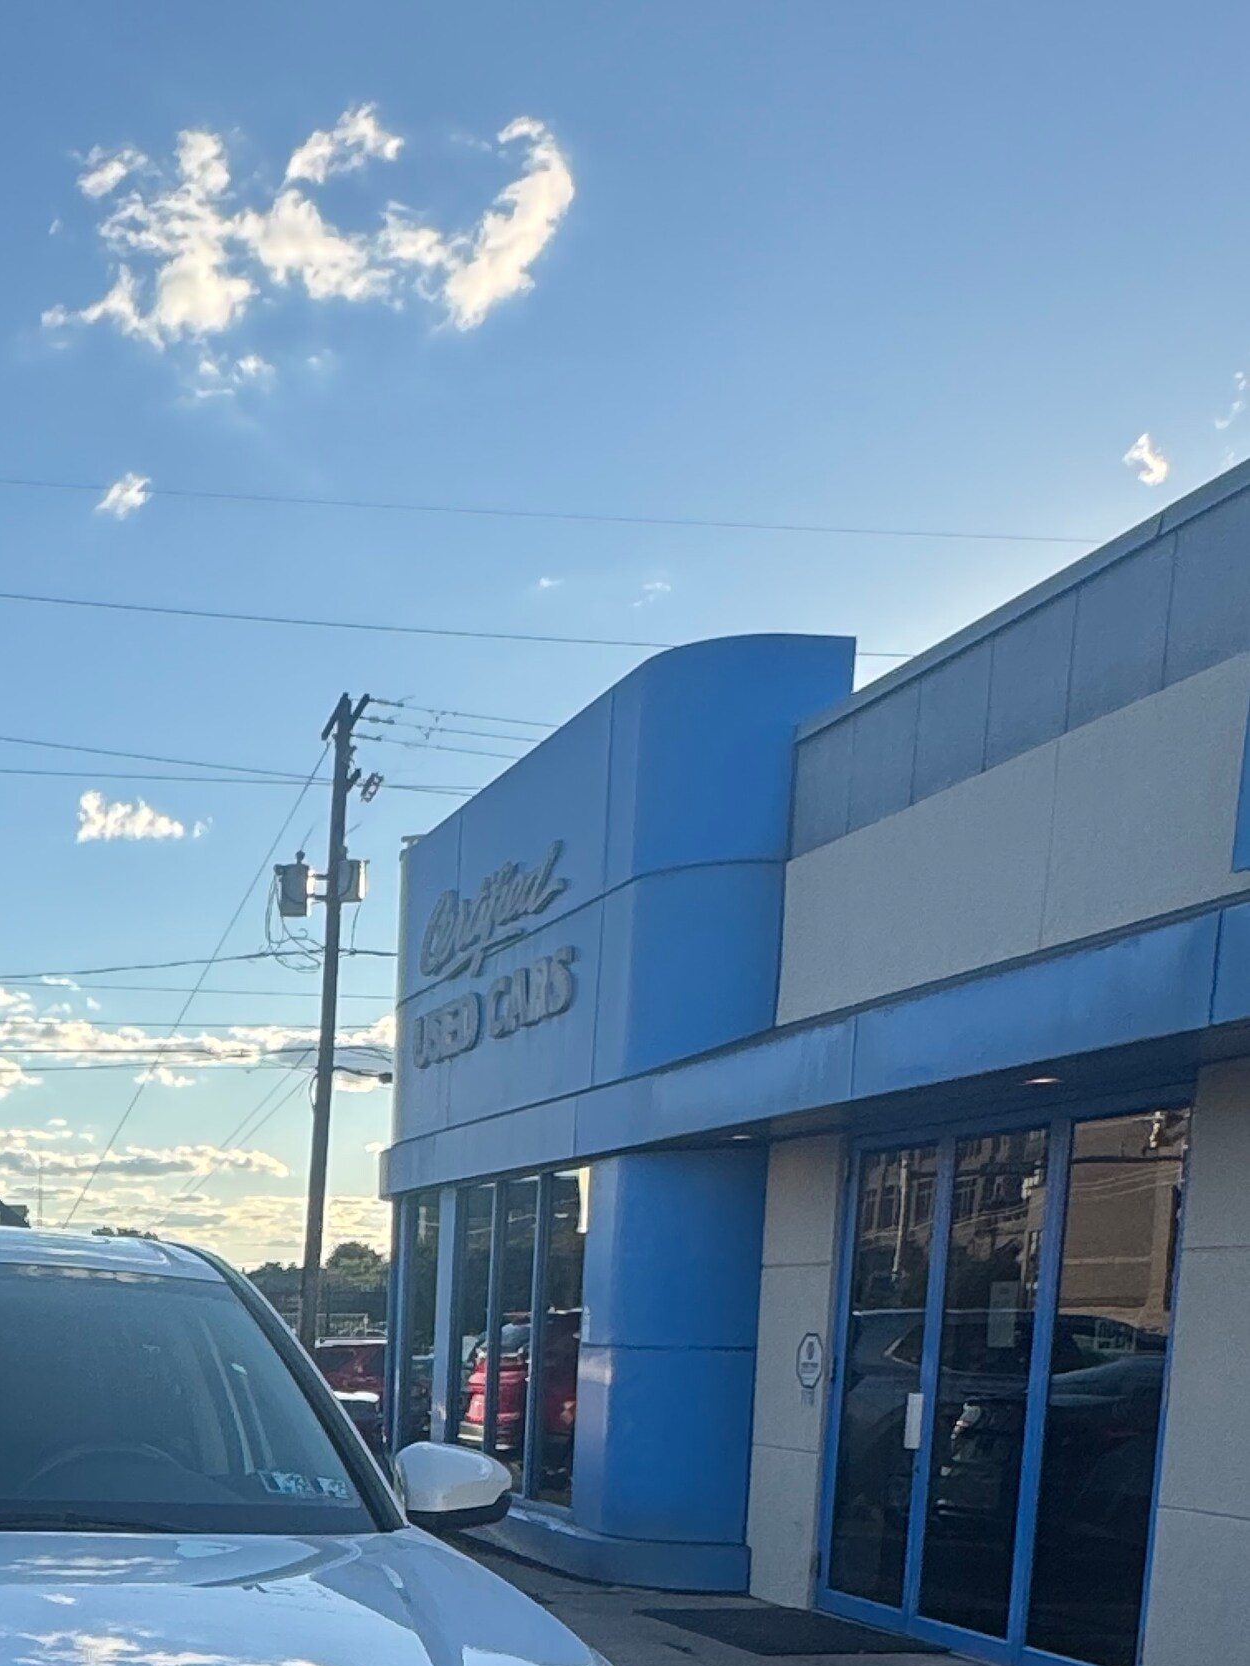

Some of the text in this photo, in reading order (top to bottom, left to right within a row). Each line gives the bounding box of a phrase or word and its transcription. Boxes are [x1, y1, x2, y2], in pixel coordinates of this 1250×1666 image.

[420, 839, 566, 978] Certified
[412, 944, 576, 1069] USED CARS
